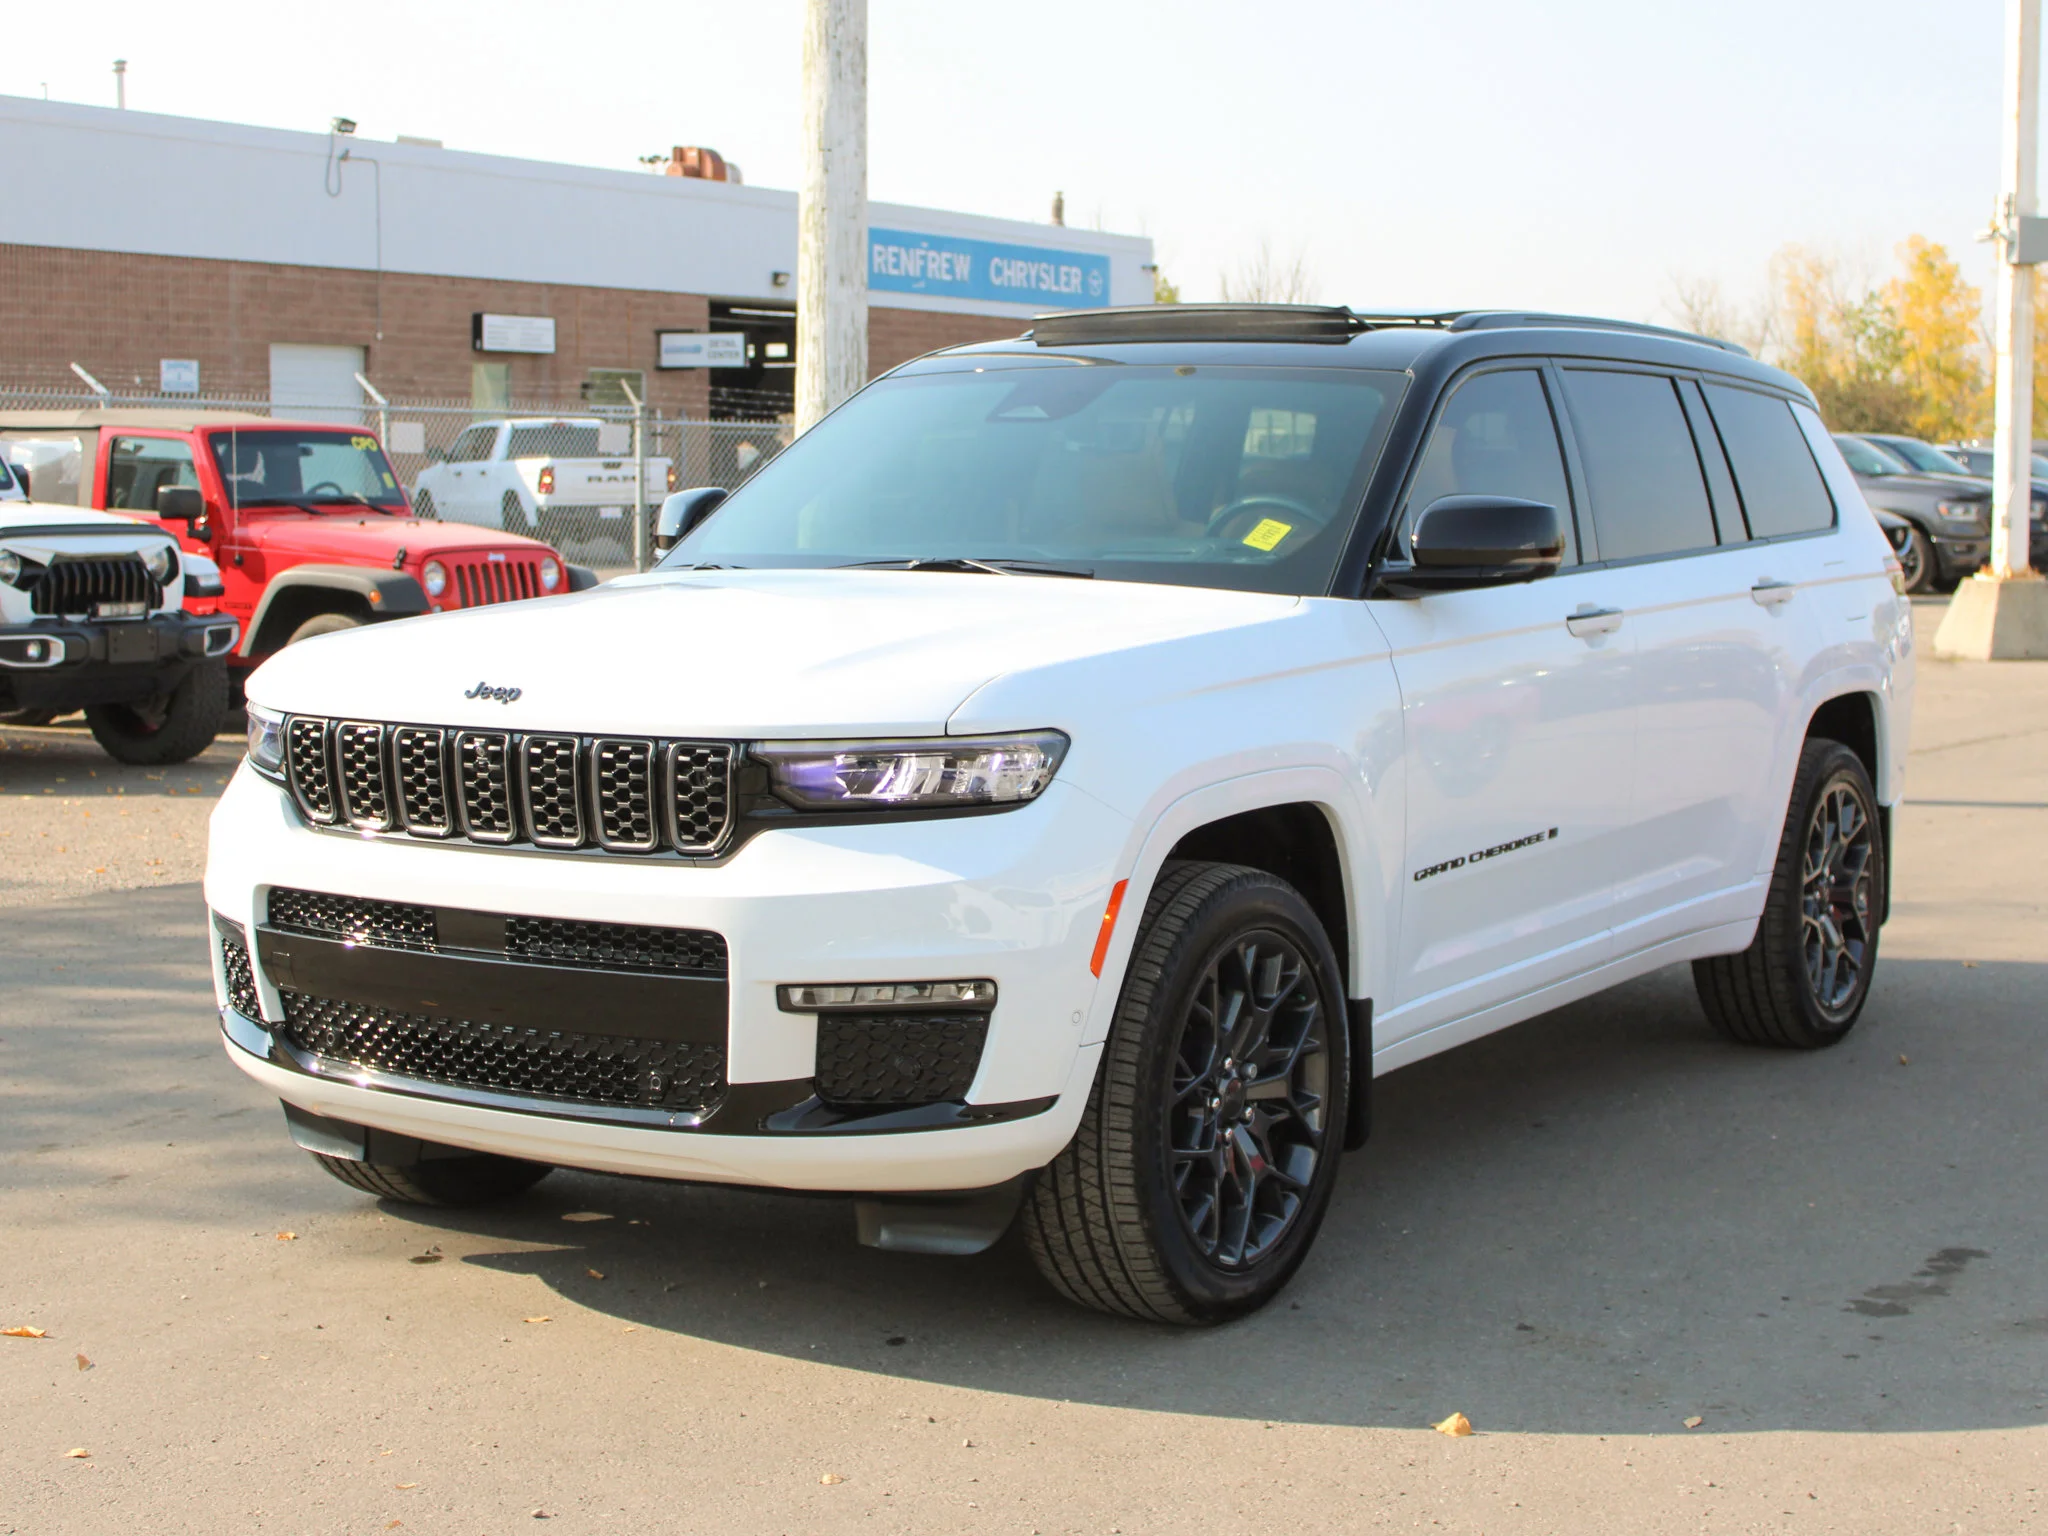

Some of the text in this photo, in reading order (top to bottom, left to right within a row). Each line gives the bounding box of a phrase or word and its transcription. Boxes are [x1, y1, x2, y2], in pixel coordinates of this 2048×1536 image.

[872, 244, 1082, 294] RENFREW CHRYSLER
[587, 475, 637, 483] RAM
[464, 681, 522, 705] Jeep
[1413, 856, 1466, 882] GRAND
[1468, 831, 1546, 864] CHEROKEE
